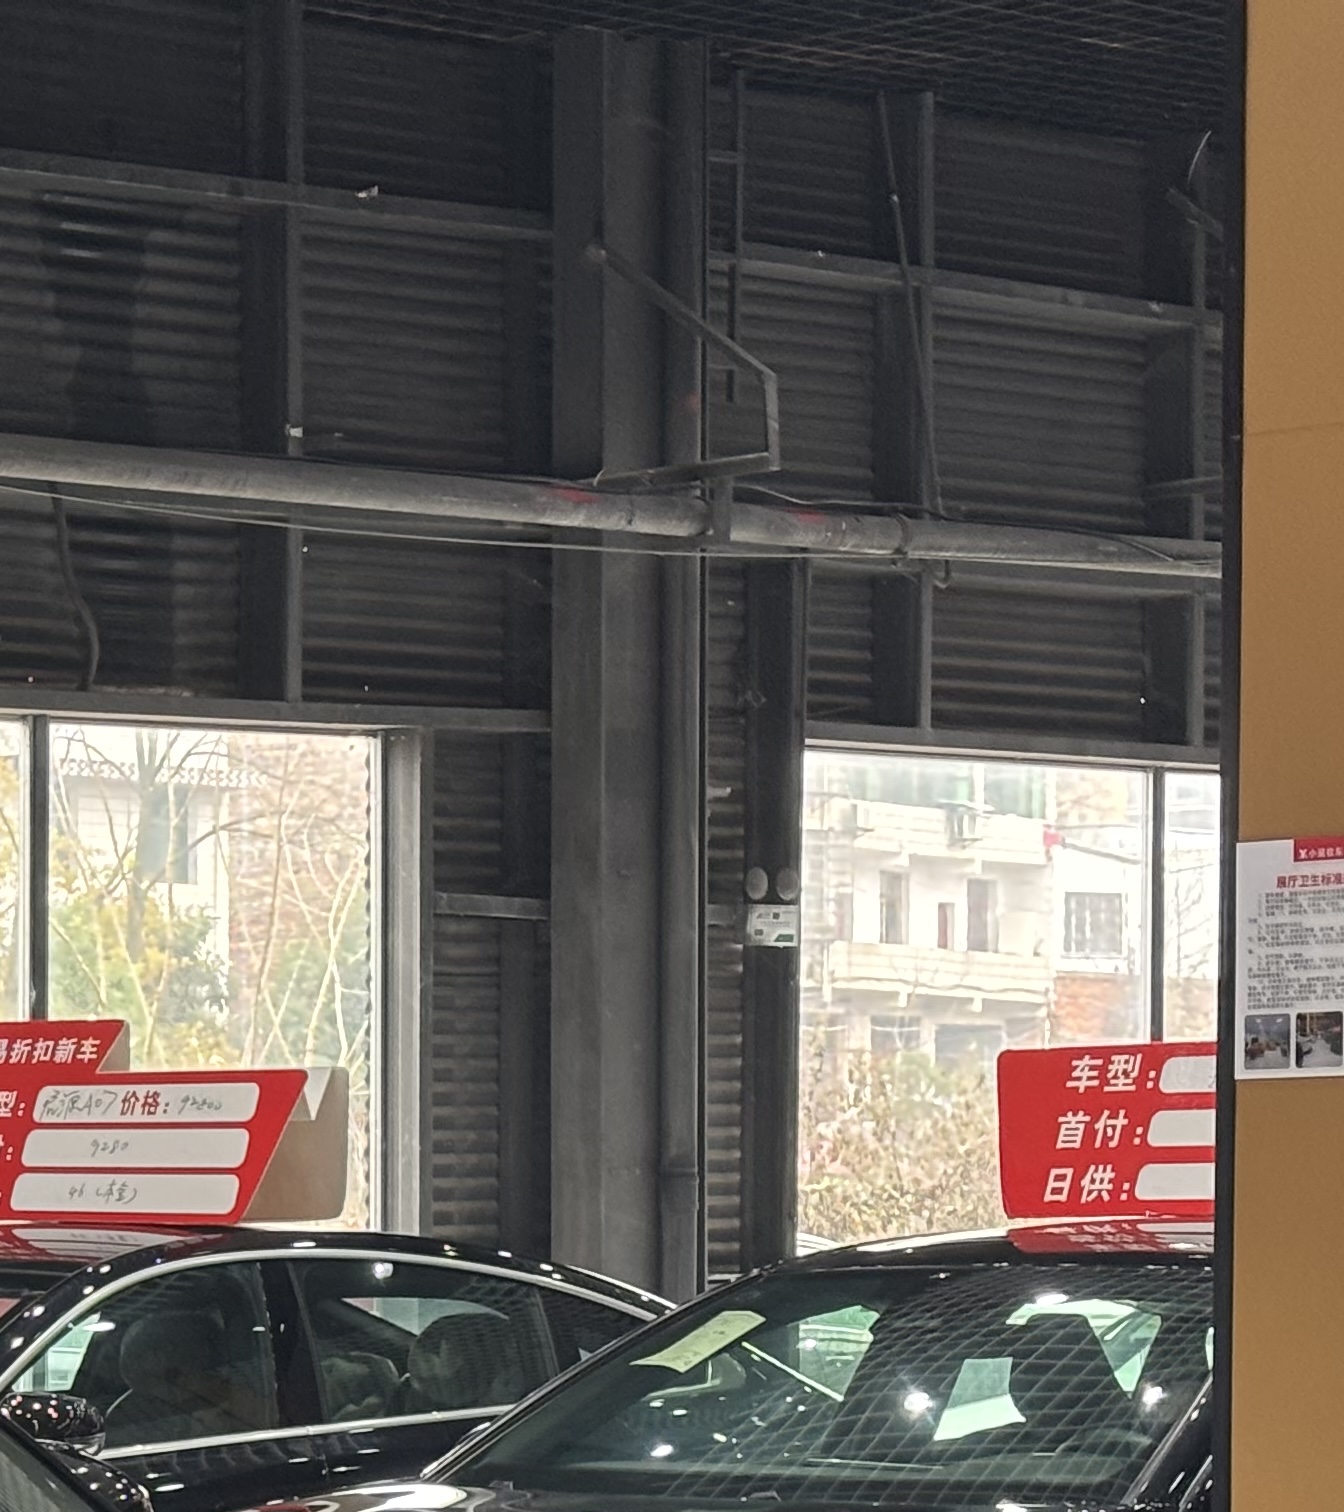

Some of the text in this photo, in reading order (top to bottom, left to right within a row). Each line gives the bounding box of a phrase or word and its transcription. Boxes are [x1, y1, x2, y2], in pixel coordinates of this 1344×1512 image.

[1064, 1052, 1156, 1094] 车型：
[1054, 1109, 1143, 1150] 首付：
[1042, 1163, 1130, 1204] 日供：
